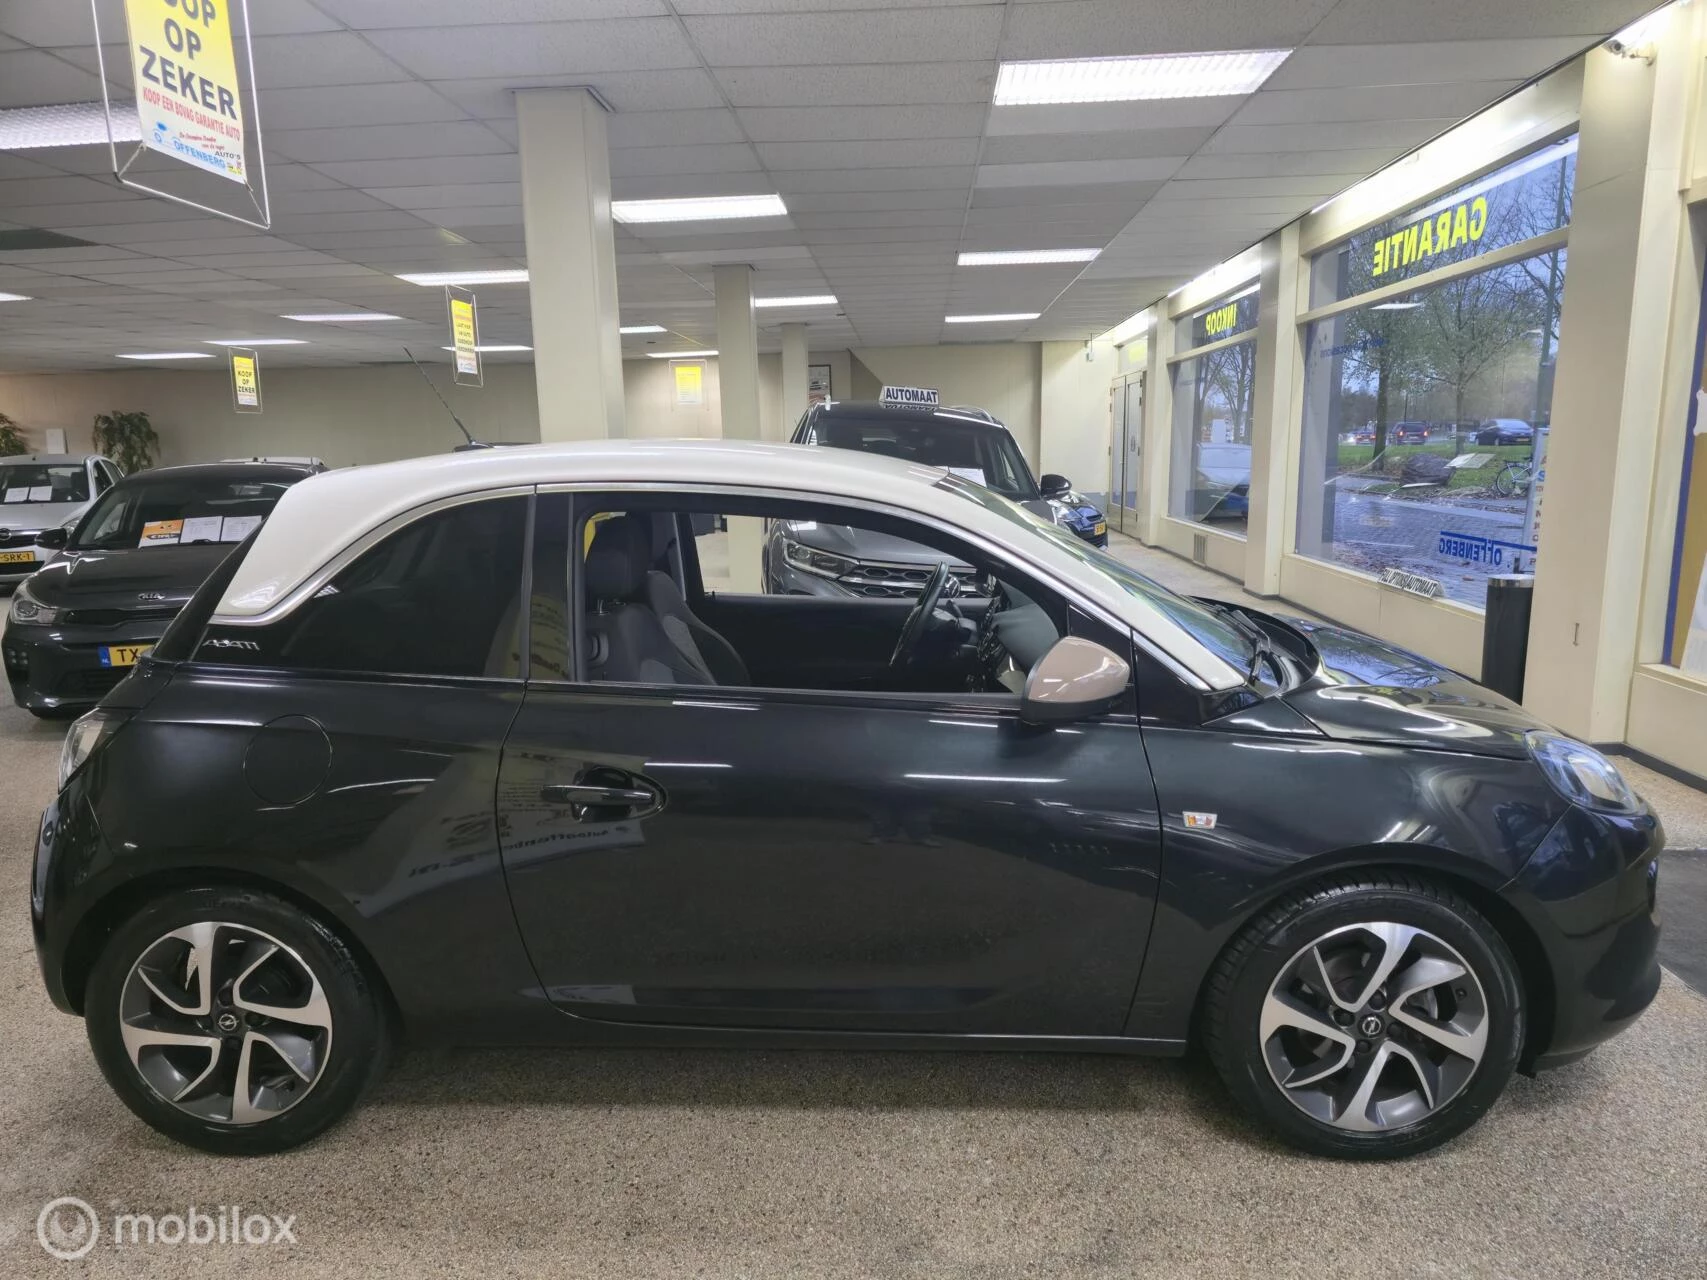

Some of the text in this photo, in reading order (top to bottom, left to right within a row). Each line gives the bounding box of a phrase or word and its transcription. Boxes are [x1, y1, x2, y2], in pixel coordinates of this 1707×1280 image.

[164, 18, 202, 60] OP
[139, 45, 237, 120] ZEKER
[143, 87, 160, 106] KOOP
[162, 95, 174, 112] EEN
[175, 101, 194, 121] BOVAG
[195, 110, 225, 134] GARANTIE
[225, 124, 240, 142] AUTO
[173, 139, 227, 169] OFFENBERG
[238, 385, 255, 393] ZEKER
[885, 387, 938, 404] AUTOMAAT
[116, 648, 139, 663] TX
